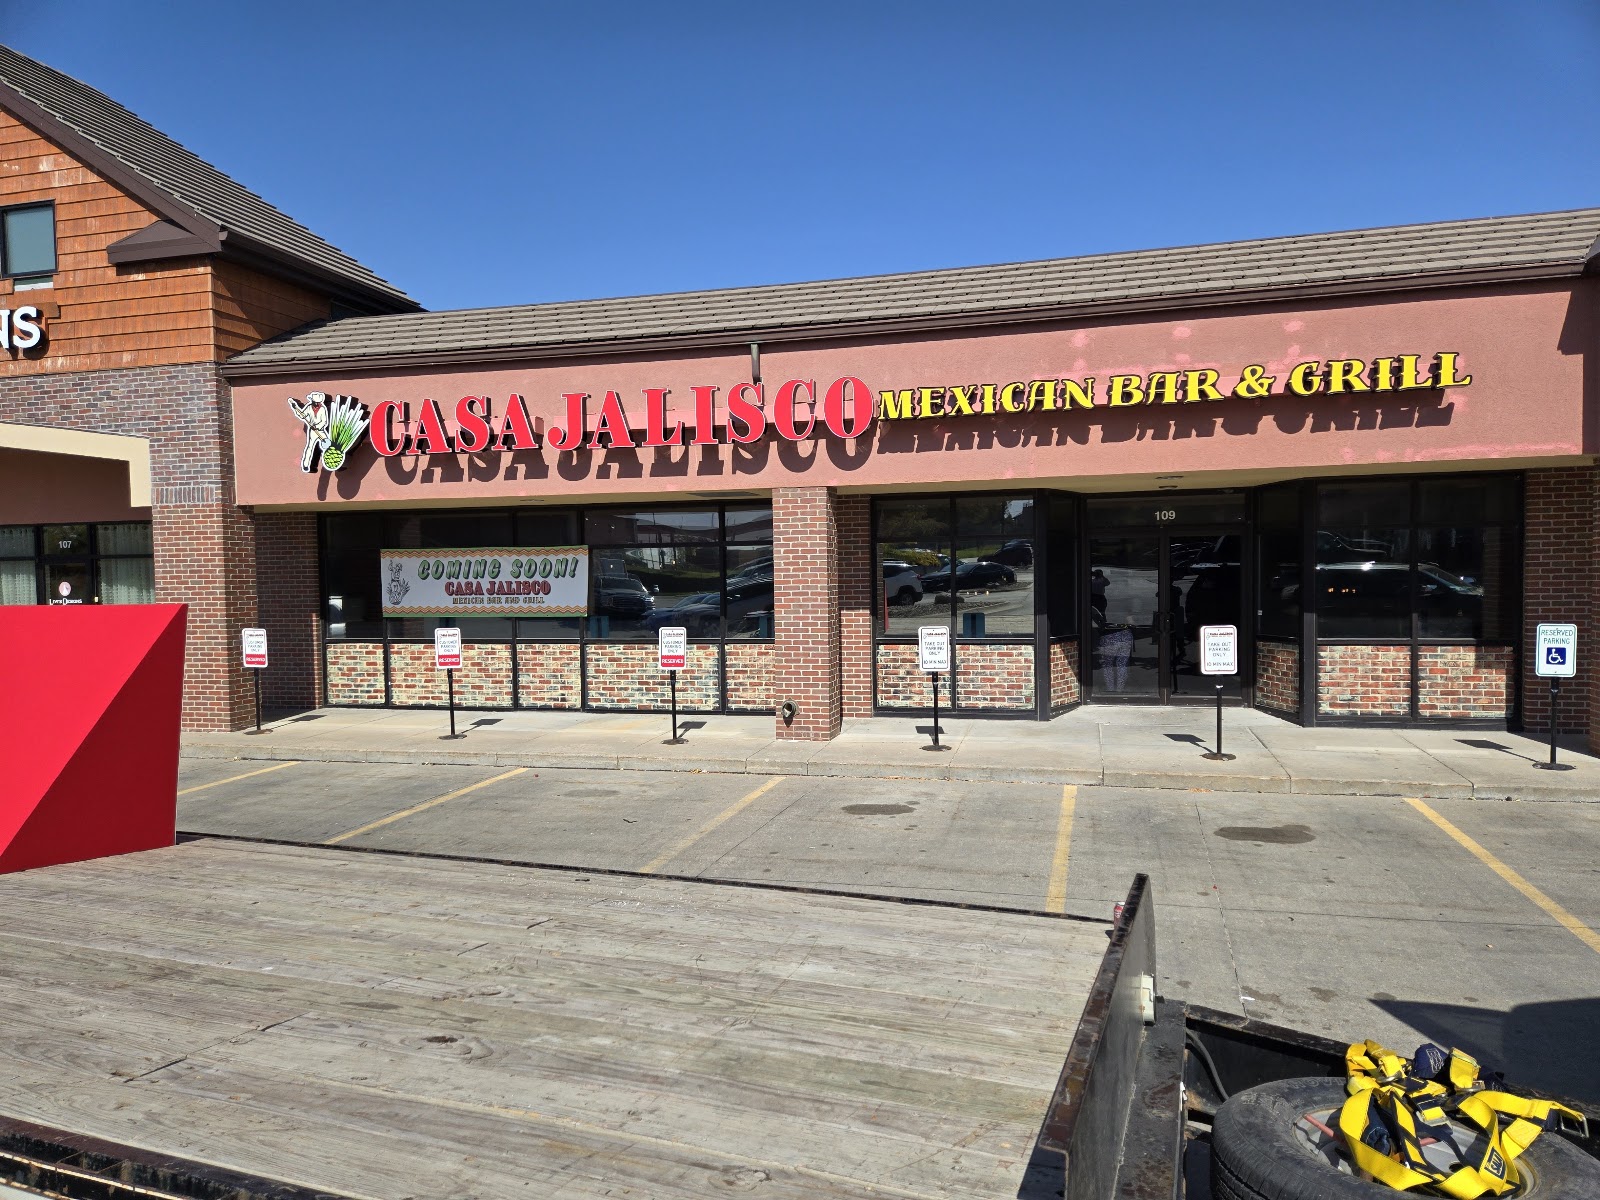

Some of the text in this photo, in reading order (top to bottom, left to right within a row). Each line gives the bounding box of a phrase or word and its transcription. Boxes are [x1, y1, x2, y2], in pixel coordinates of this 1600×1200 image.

[369, 352, 1473, 456] CASA JALISCO MEXICAN BAR & GRILL
[1154, 510, 1176, 521] 109
[58, 540, 72, 549] 107
[417, 557, 579, 581] COMING SOON!
[444, 579, 551, 597] CASA JALISCO
[1543, 637, 1571, 645] PARKING
